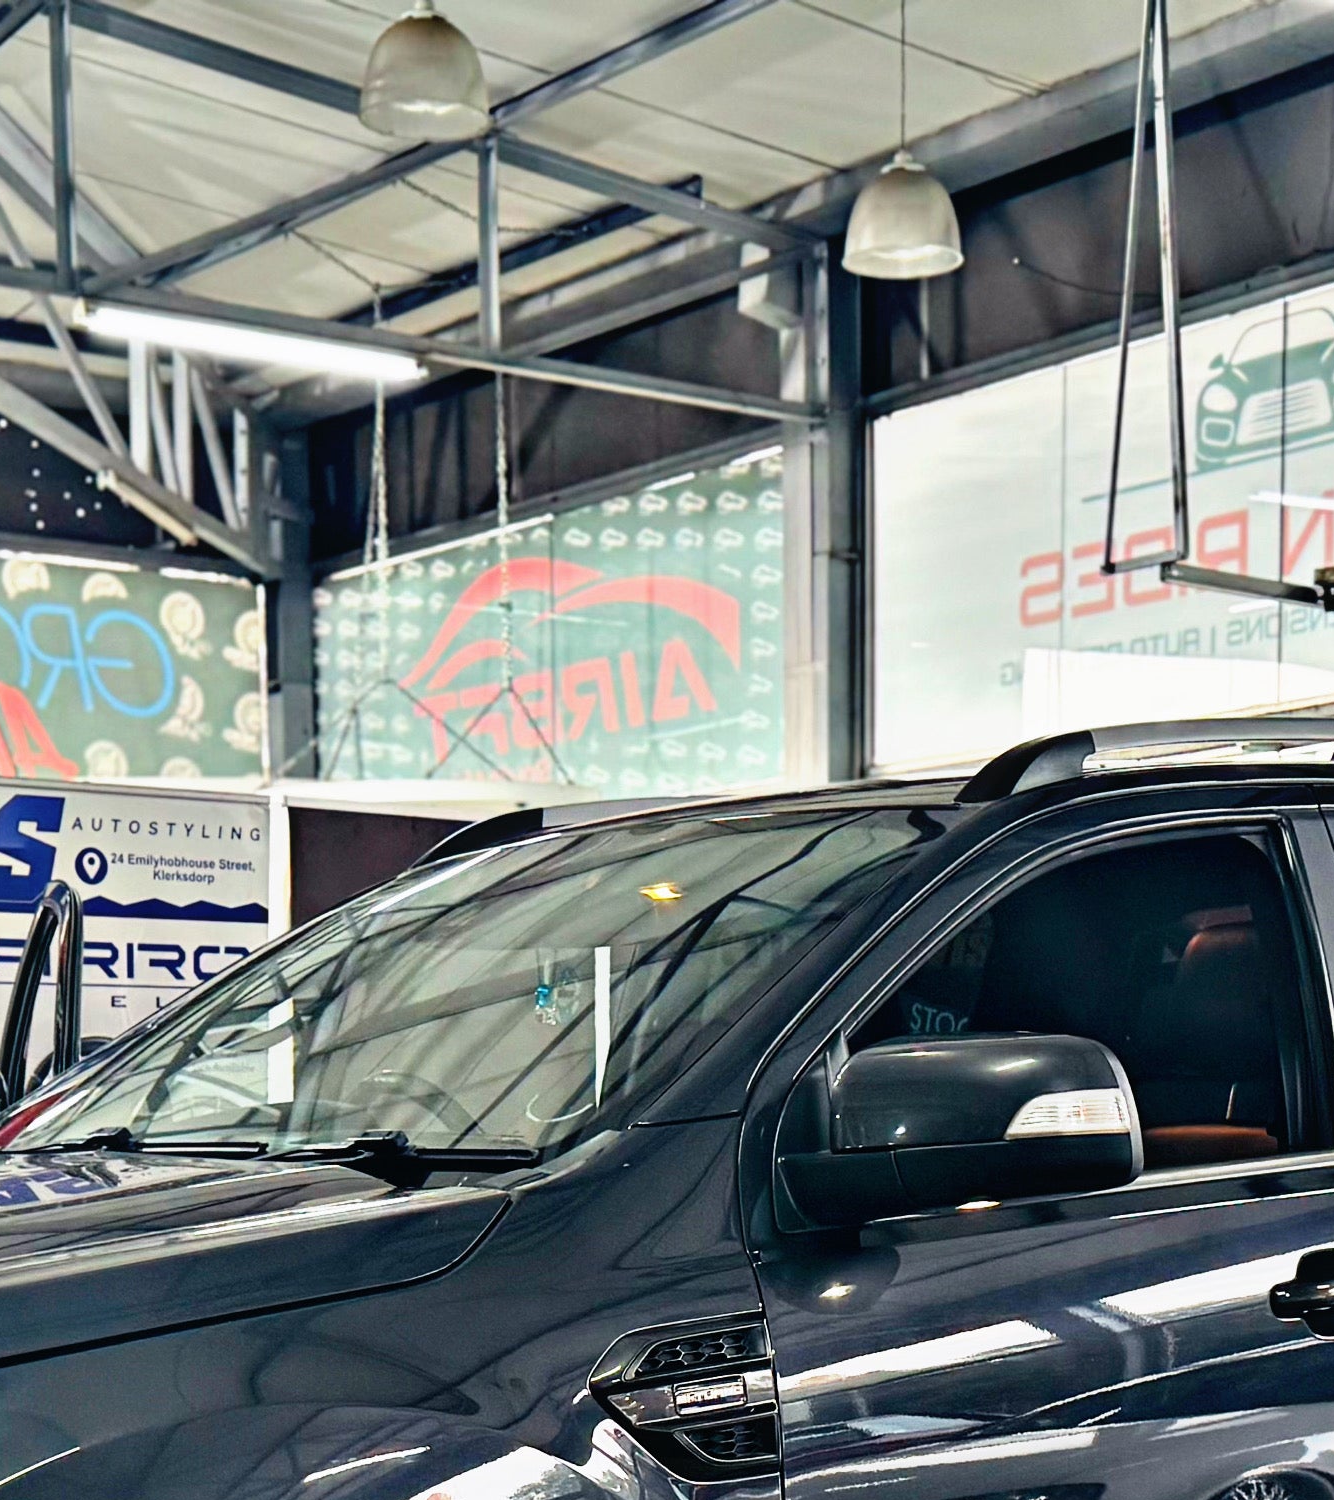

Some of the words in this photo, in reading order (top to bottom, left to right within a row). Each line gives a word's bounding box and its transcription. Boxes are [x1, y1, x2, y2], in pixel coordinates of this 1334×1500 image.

[71, 816, 262, 843] AUTOSTYLING
[110, 852, 125, 865] 24
[127, 854, 216, 871] Emilyhobhouse
[218, 858, 256, 873] Street,
[152, 869, 216, 884] Klerksdorp
